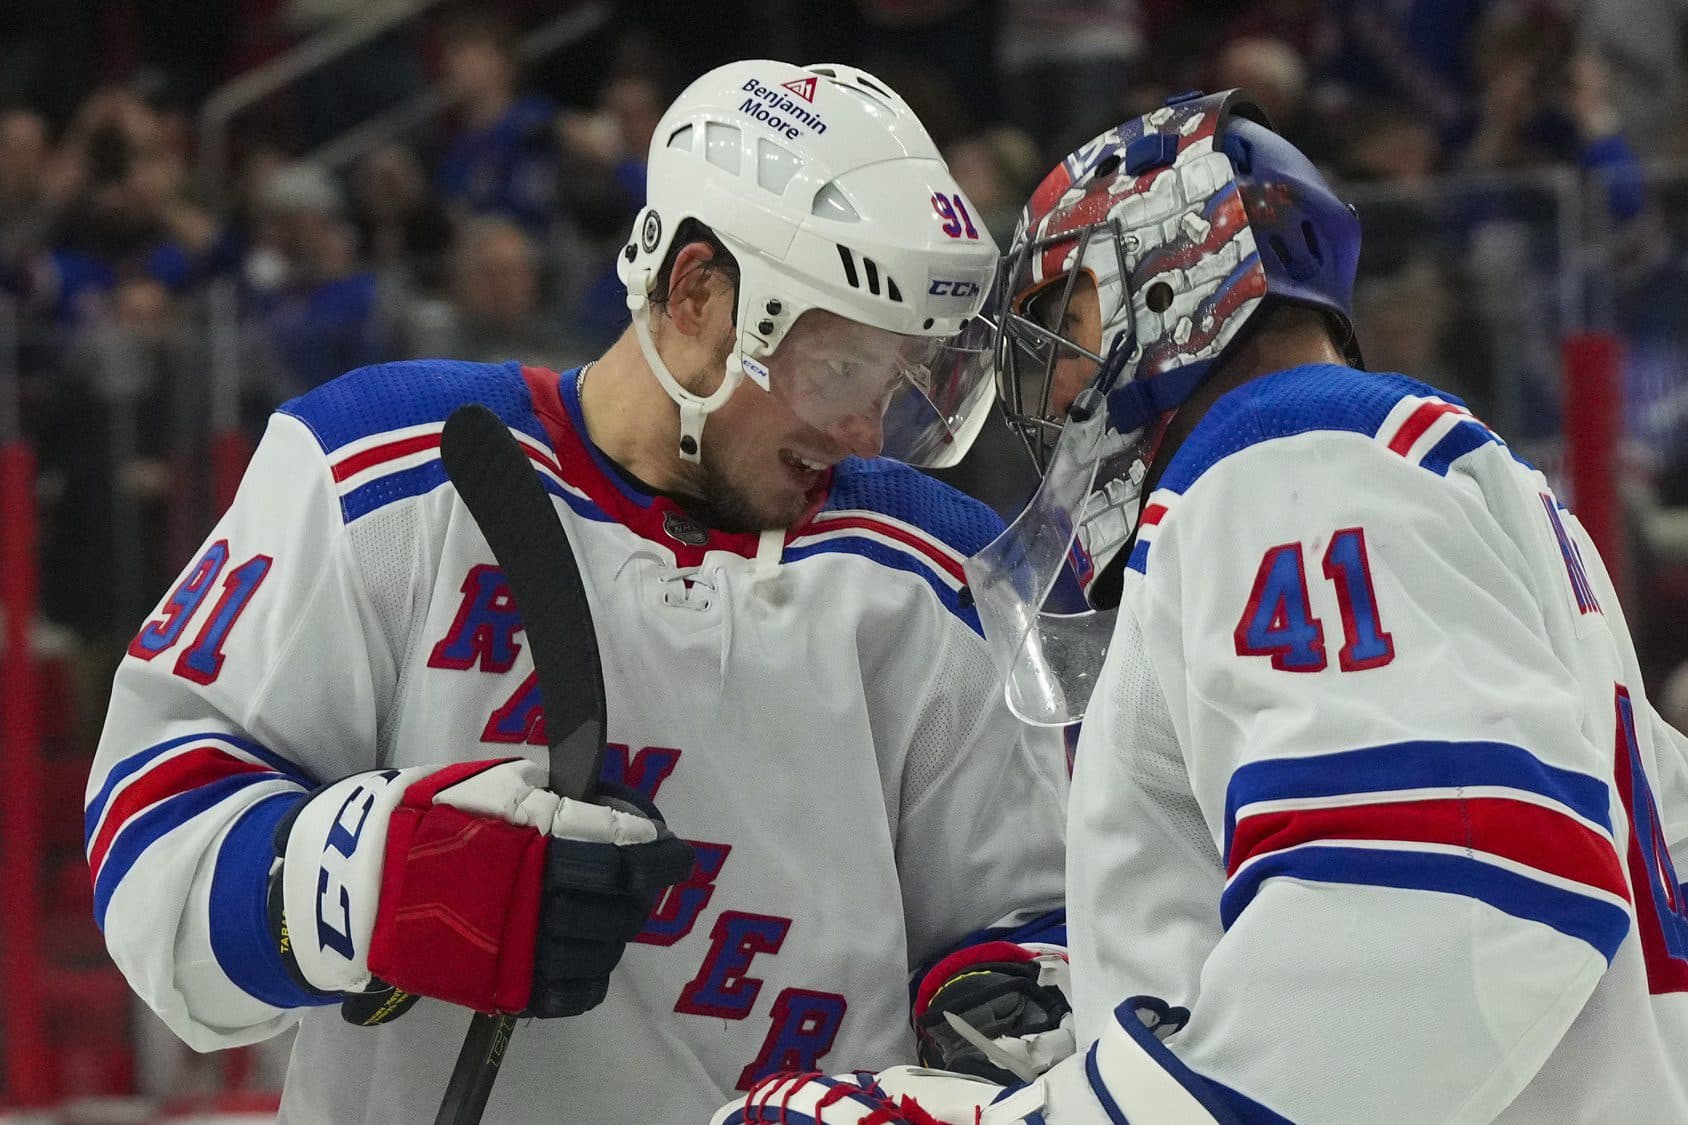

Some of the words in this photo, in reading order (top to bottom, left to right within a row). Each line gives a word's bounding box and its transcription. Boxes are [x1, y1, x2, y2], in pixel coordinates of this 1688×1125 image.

[738, 98, 799, 140] Moore
[742, 78, 827, 135] Benjamin
[931, 191, 979, 240] 91
[928, 280, 980, 297] CCM
[743, 360, 767, 377] CCM
[128, 539, 273, 686] 91
[1233, 526, 1396, 673] 41
[315, 769, 402, 962] CC
